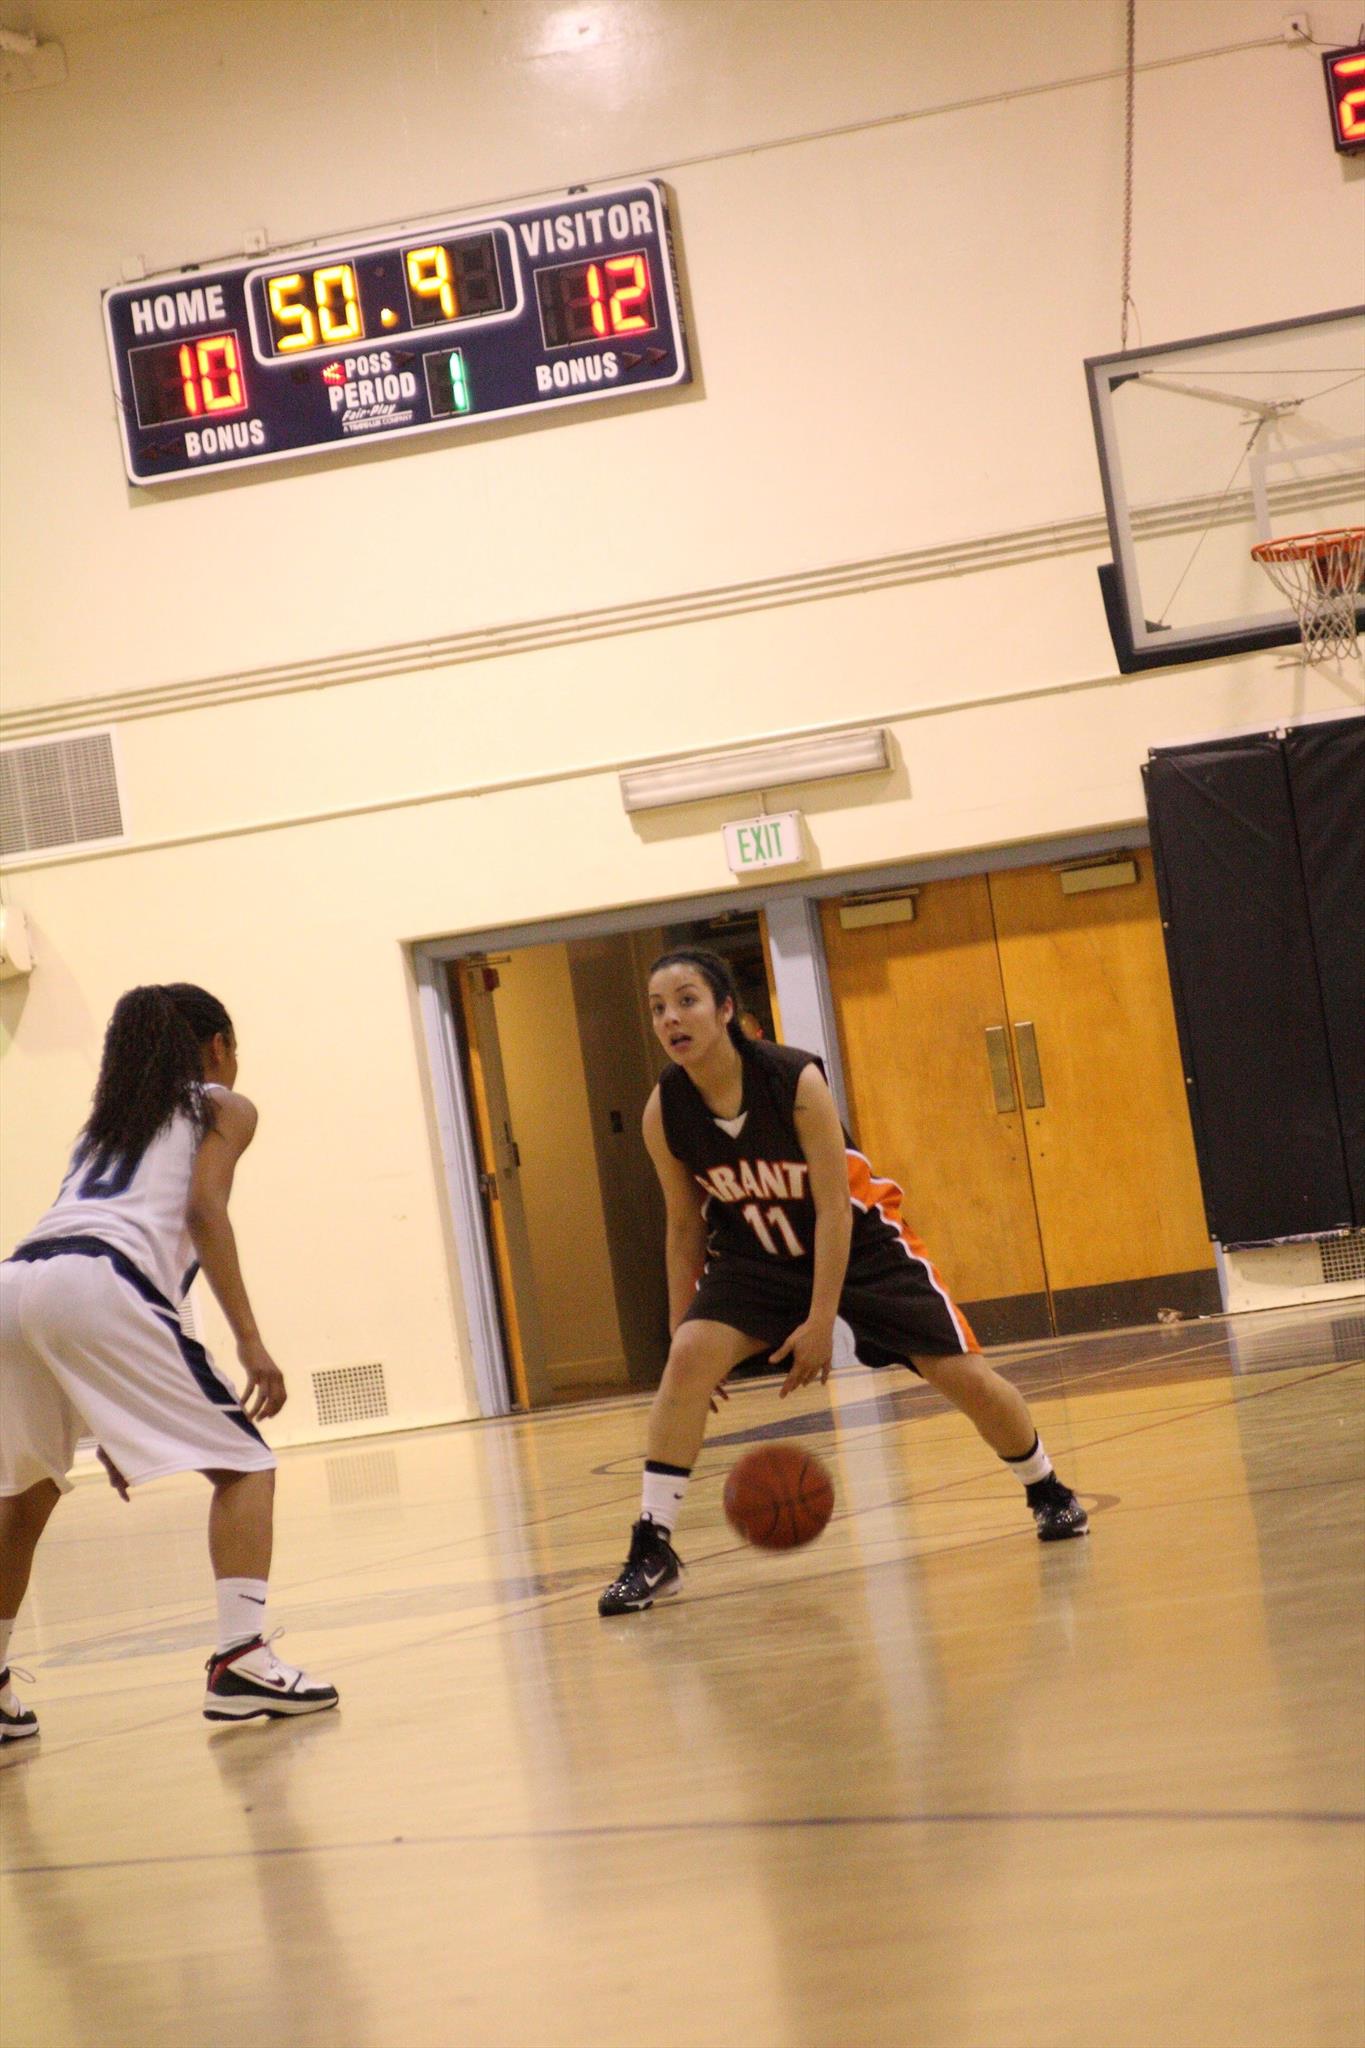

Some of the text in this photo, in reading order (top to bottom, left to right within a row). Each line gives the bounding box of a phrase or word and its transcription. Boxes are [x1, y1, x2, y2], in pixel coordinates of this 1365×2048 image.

[519, 200, 653, 257] VISITOR
[131, 285, 226, 336] HOME
[586, 253, 649, 336] 12
[179, 334, 243, 416] 10
[344, 351, 392, 378] POSS
[449, 351, 467, 411] 1
[535, 351, 619, 392] BONUS
[328, 371, 417, 412] PERIOD
[184, 419, 265, 458] BONUS
[736, 822, 782, 865] EXIT
[742, 1203, 806, 1258] 11
